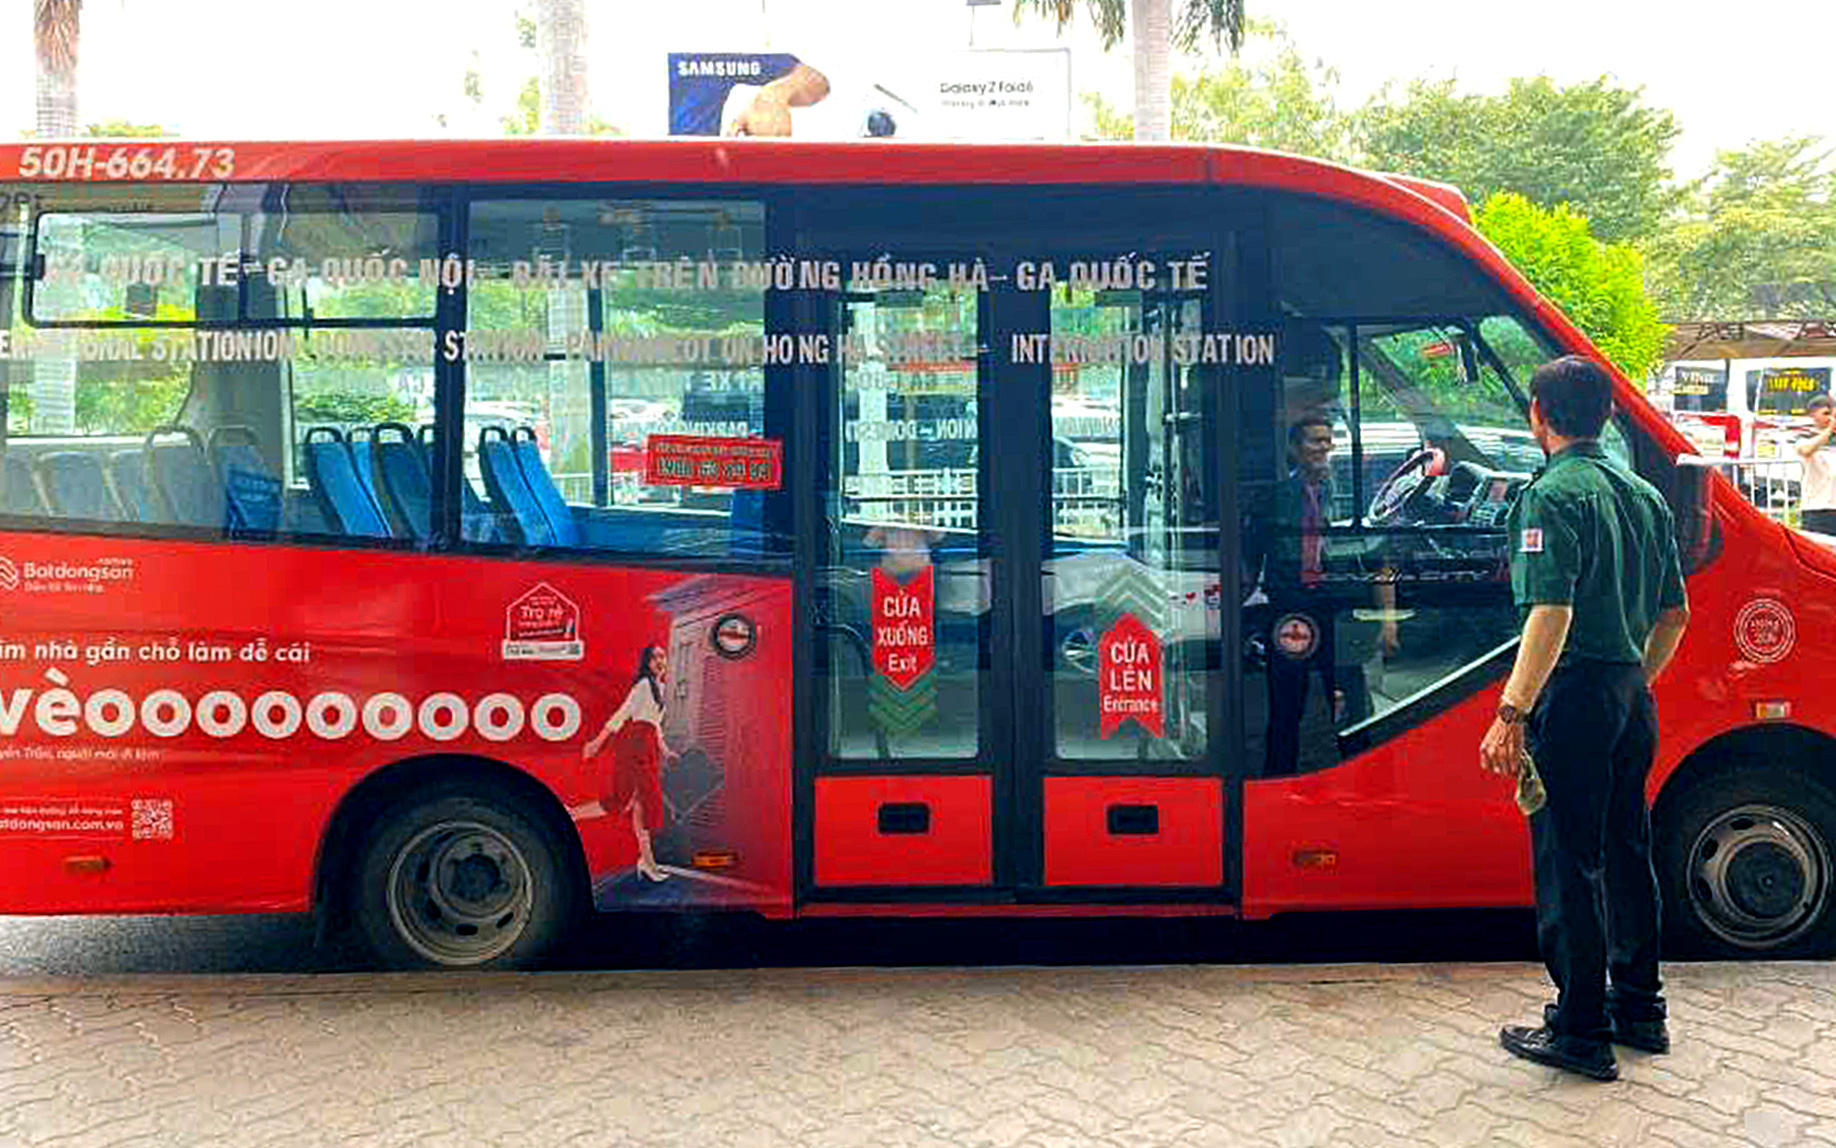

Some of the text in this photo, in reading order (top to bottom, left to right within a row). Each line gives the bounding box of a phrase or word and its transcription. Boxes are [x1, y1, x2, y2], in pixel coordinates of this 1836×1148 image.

[678, 61, 761, 77] SAMSUNG
[18, 146, 236, 179] 50H-664.73
[1016, 261, 1056, 291] GA
[1069, 251, 1156, 291] QUỐC
[1167, 251, 1211, 291] TẾ
[35, 639, 78, 660] nhà
[86, 637, 130, 666] gần
[138, 637, 181, 661] chỗ
[188, 641, 232, 662] làm
[239, 637, 268, 662] dễ
[275, 641, 311, 663] cái
[888, 653, 917, 674] Exit
[1110, 663, 1153, 692] LÊN
[1103, 694, 1160, 713] Entrance
